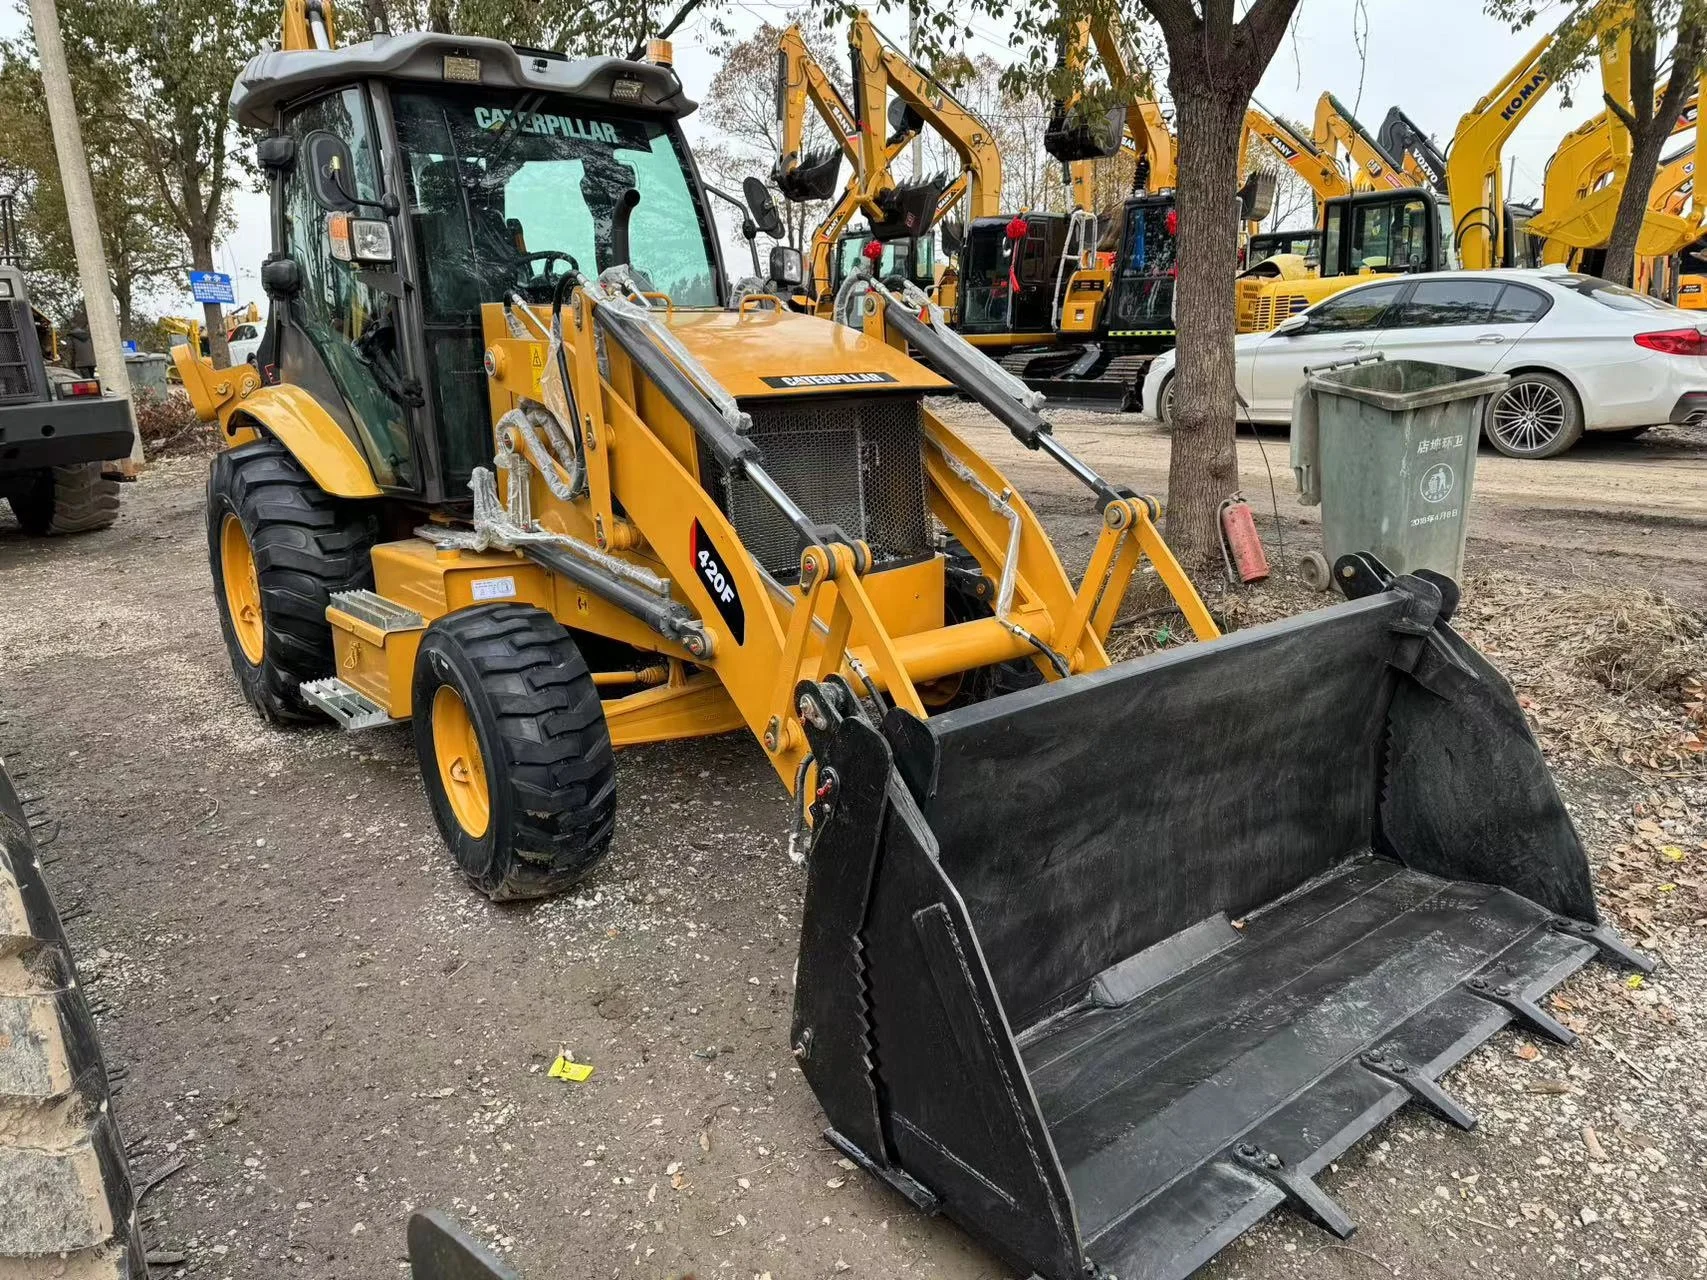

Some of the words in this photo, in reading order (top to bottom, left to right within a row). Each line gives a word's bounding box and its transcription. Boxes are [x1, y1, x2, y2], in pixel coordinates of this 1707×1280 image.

[474, 106, 619, 143] CATERPILLAR
[832, 106, 853, 134] SANY
[1121, 136, 1137, 151] SAN
[1270, 137, 1292, 157] SANY
[1366, 159, 1382, 174] CAT
[1412, 148, 1438, 183] VOLVO
[780, 373, 885, 387] CATERPILLAR
[698, 550, 735, 603] 420F
